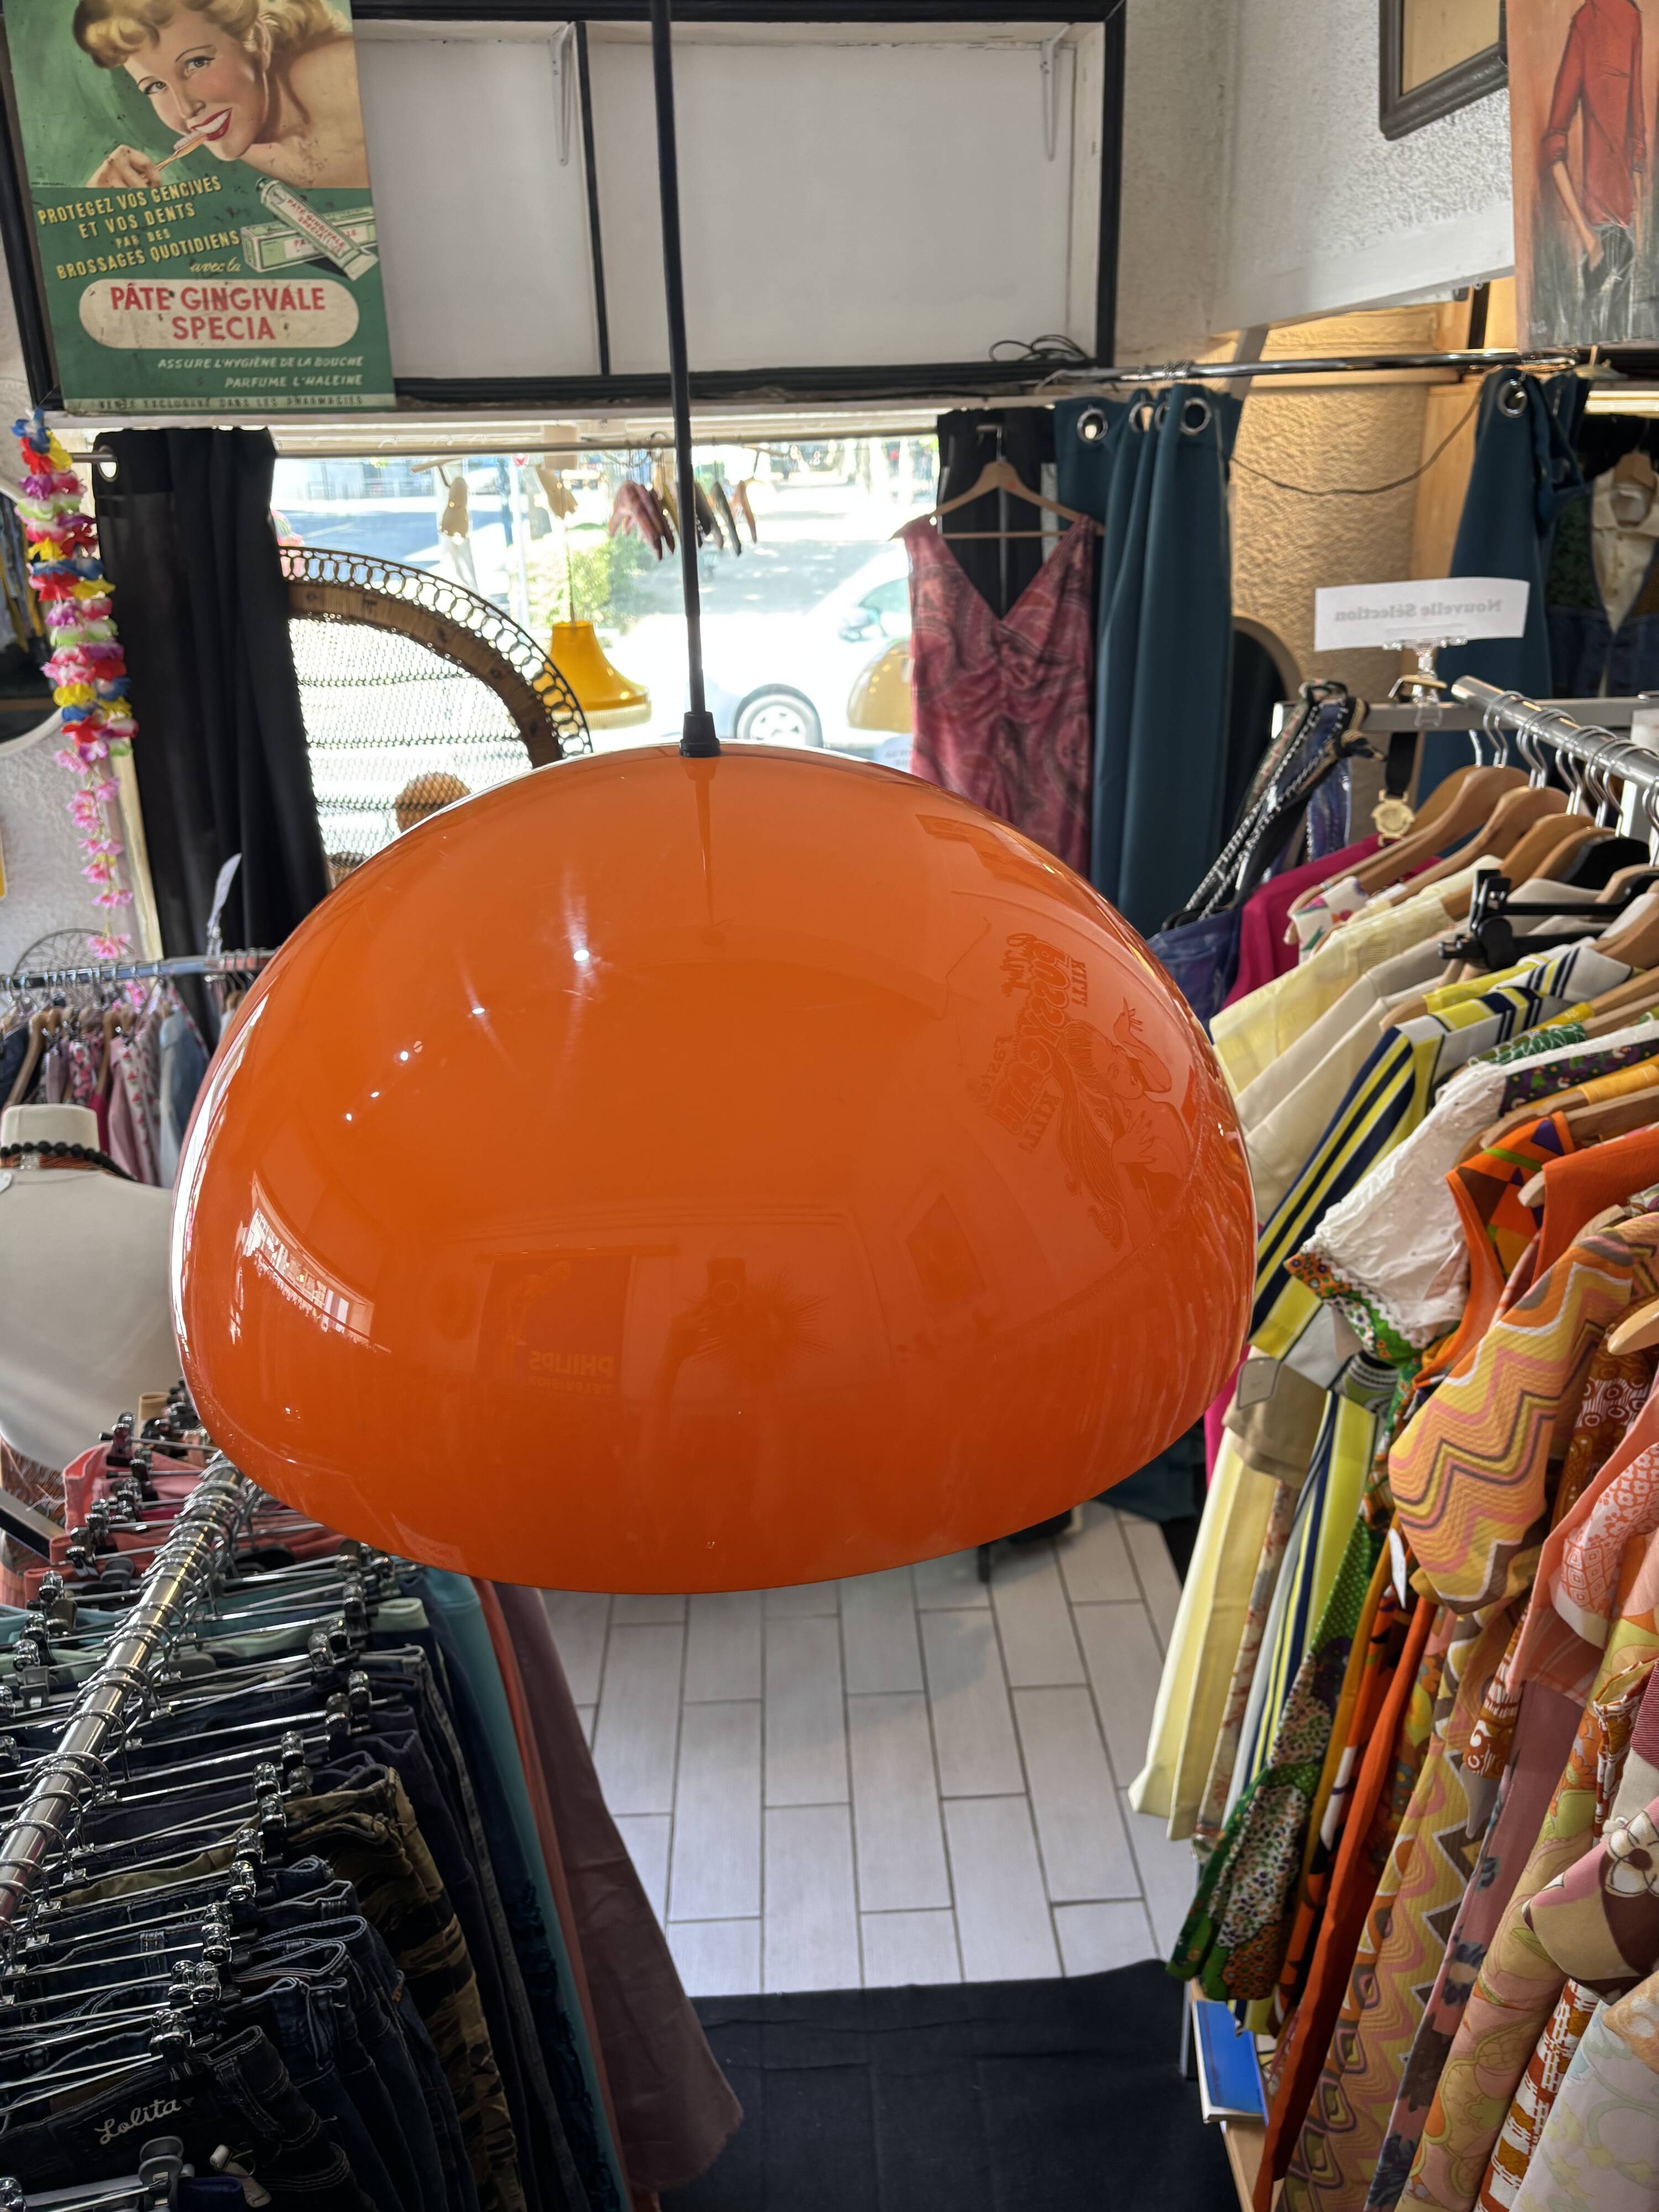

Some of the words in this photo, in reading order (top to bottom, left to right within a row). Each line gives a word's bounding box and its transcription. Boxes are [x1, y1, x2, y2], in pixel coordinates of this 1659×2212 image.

[116, 192, 148, 210] VOS
[150, 175, 222, 204] GENCIVES
[79, 222, 99, 238] ET
[105, 214, 138, 234] VOS
[144, 202, 196, 226] DENTS
[115, 234, 140, 249] PAR
[146, 228, 171, 242] DES
[56, 249, 147, 280] BROSSAGES
[149, 230, 241, 263] QUOTIDIENS
[190, 259, 224, 273] avec
[225, 254, 242, 273] la
[110, 283, 171, 311] PÂTE
[180, 287, 326, 311] GINGIVALE
[171, 316, 276, 340] SPECIA
[158, 358, 212, 369] ASSURE
[213, 355, 278, 369] L'HYGIÈNE
[279, 357, 294, 368] DE
[296, 357, 312, 368] LA
[314, 356, 364, 367] BOUCHE
[225, 377, 288, 388] PARFUME
[293, 374, 363, 387] L'HALEINE
[94, 2098, 182, 2146] Lolita
